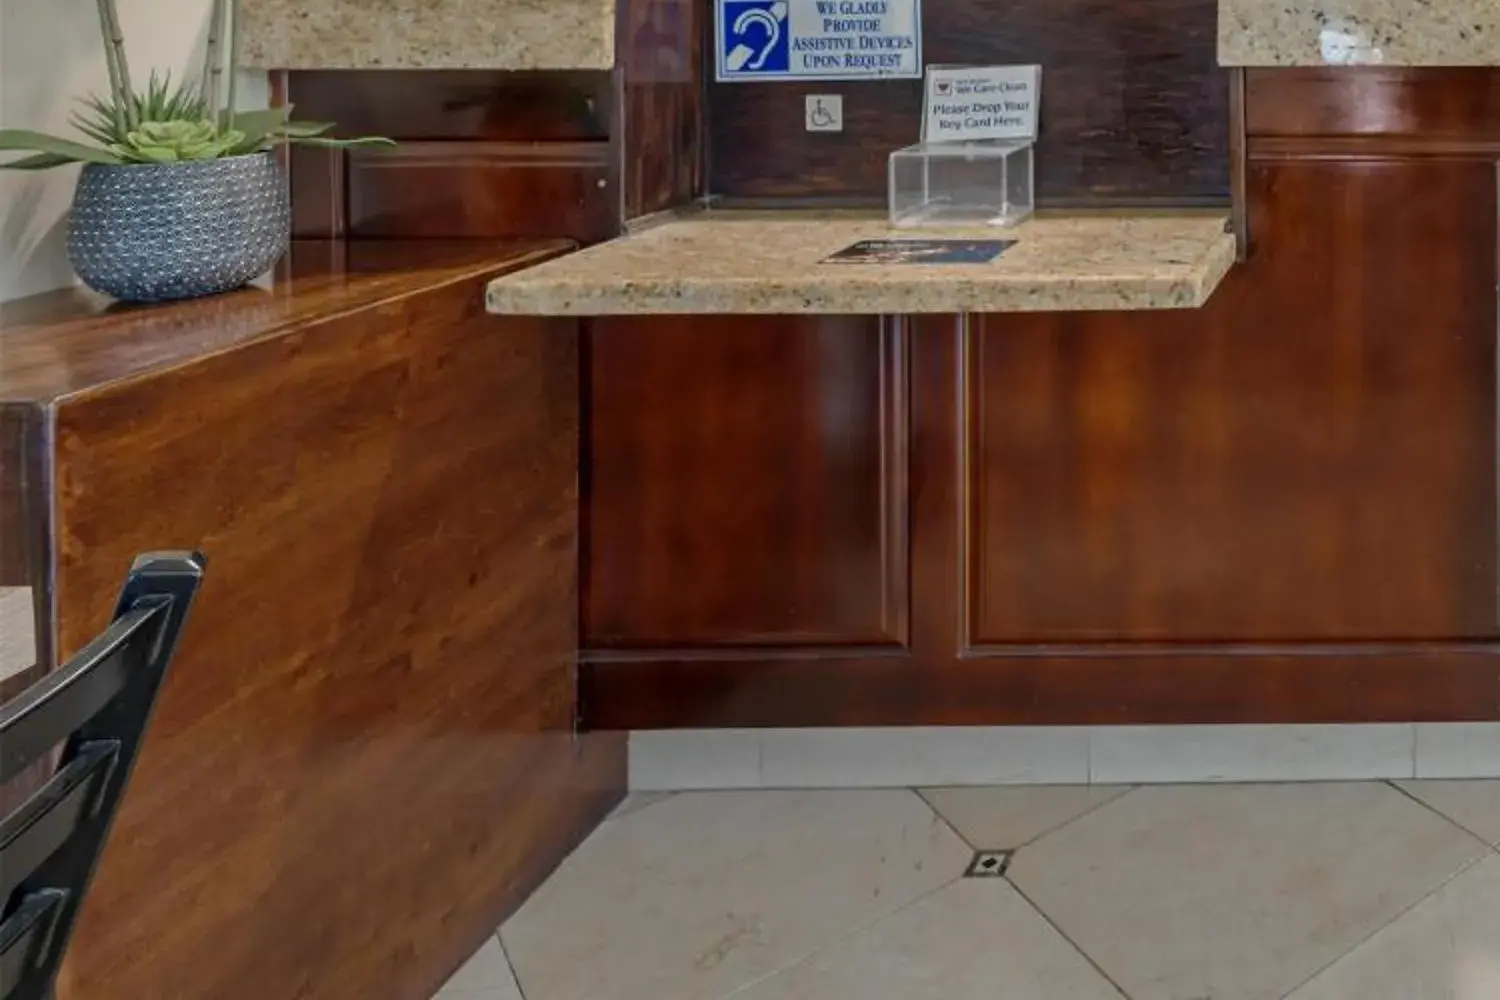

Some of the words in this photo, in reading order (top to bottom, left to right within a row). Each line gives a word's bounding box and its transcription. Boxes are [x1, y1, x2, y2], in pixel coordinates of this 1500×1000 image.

[816, 1, 837, 14] WE
[840, 1, 888, 14] GLADLY
[823, 20, 880, 33] PROVIDE
[793, 37, 854, 51] ASSISTIVE
[859, 35, 913, 49] DEVICES
[803, 53, 841, 67] UPON
[844, 53, 902, 68] REQUEST
[933, 103, 970, 115] Please
[972, 102, 1001, 114] Drop
[1004, 100, 1030, 112] Your
[940, 119, 961, 131] Key
[964, 117, 991, 128] Card
